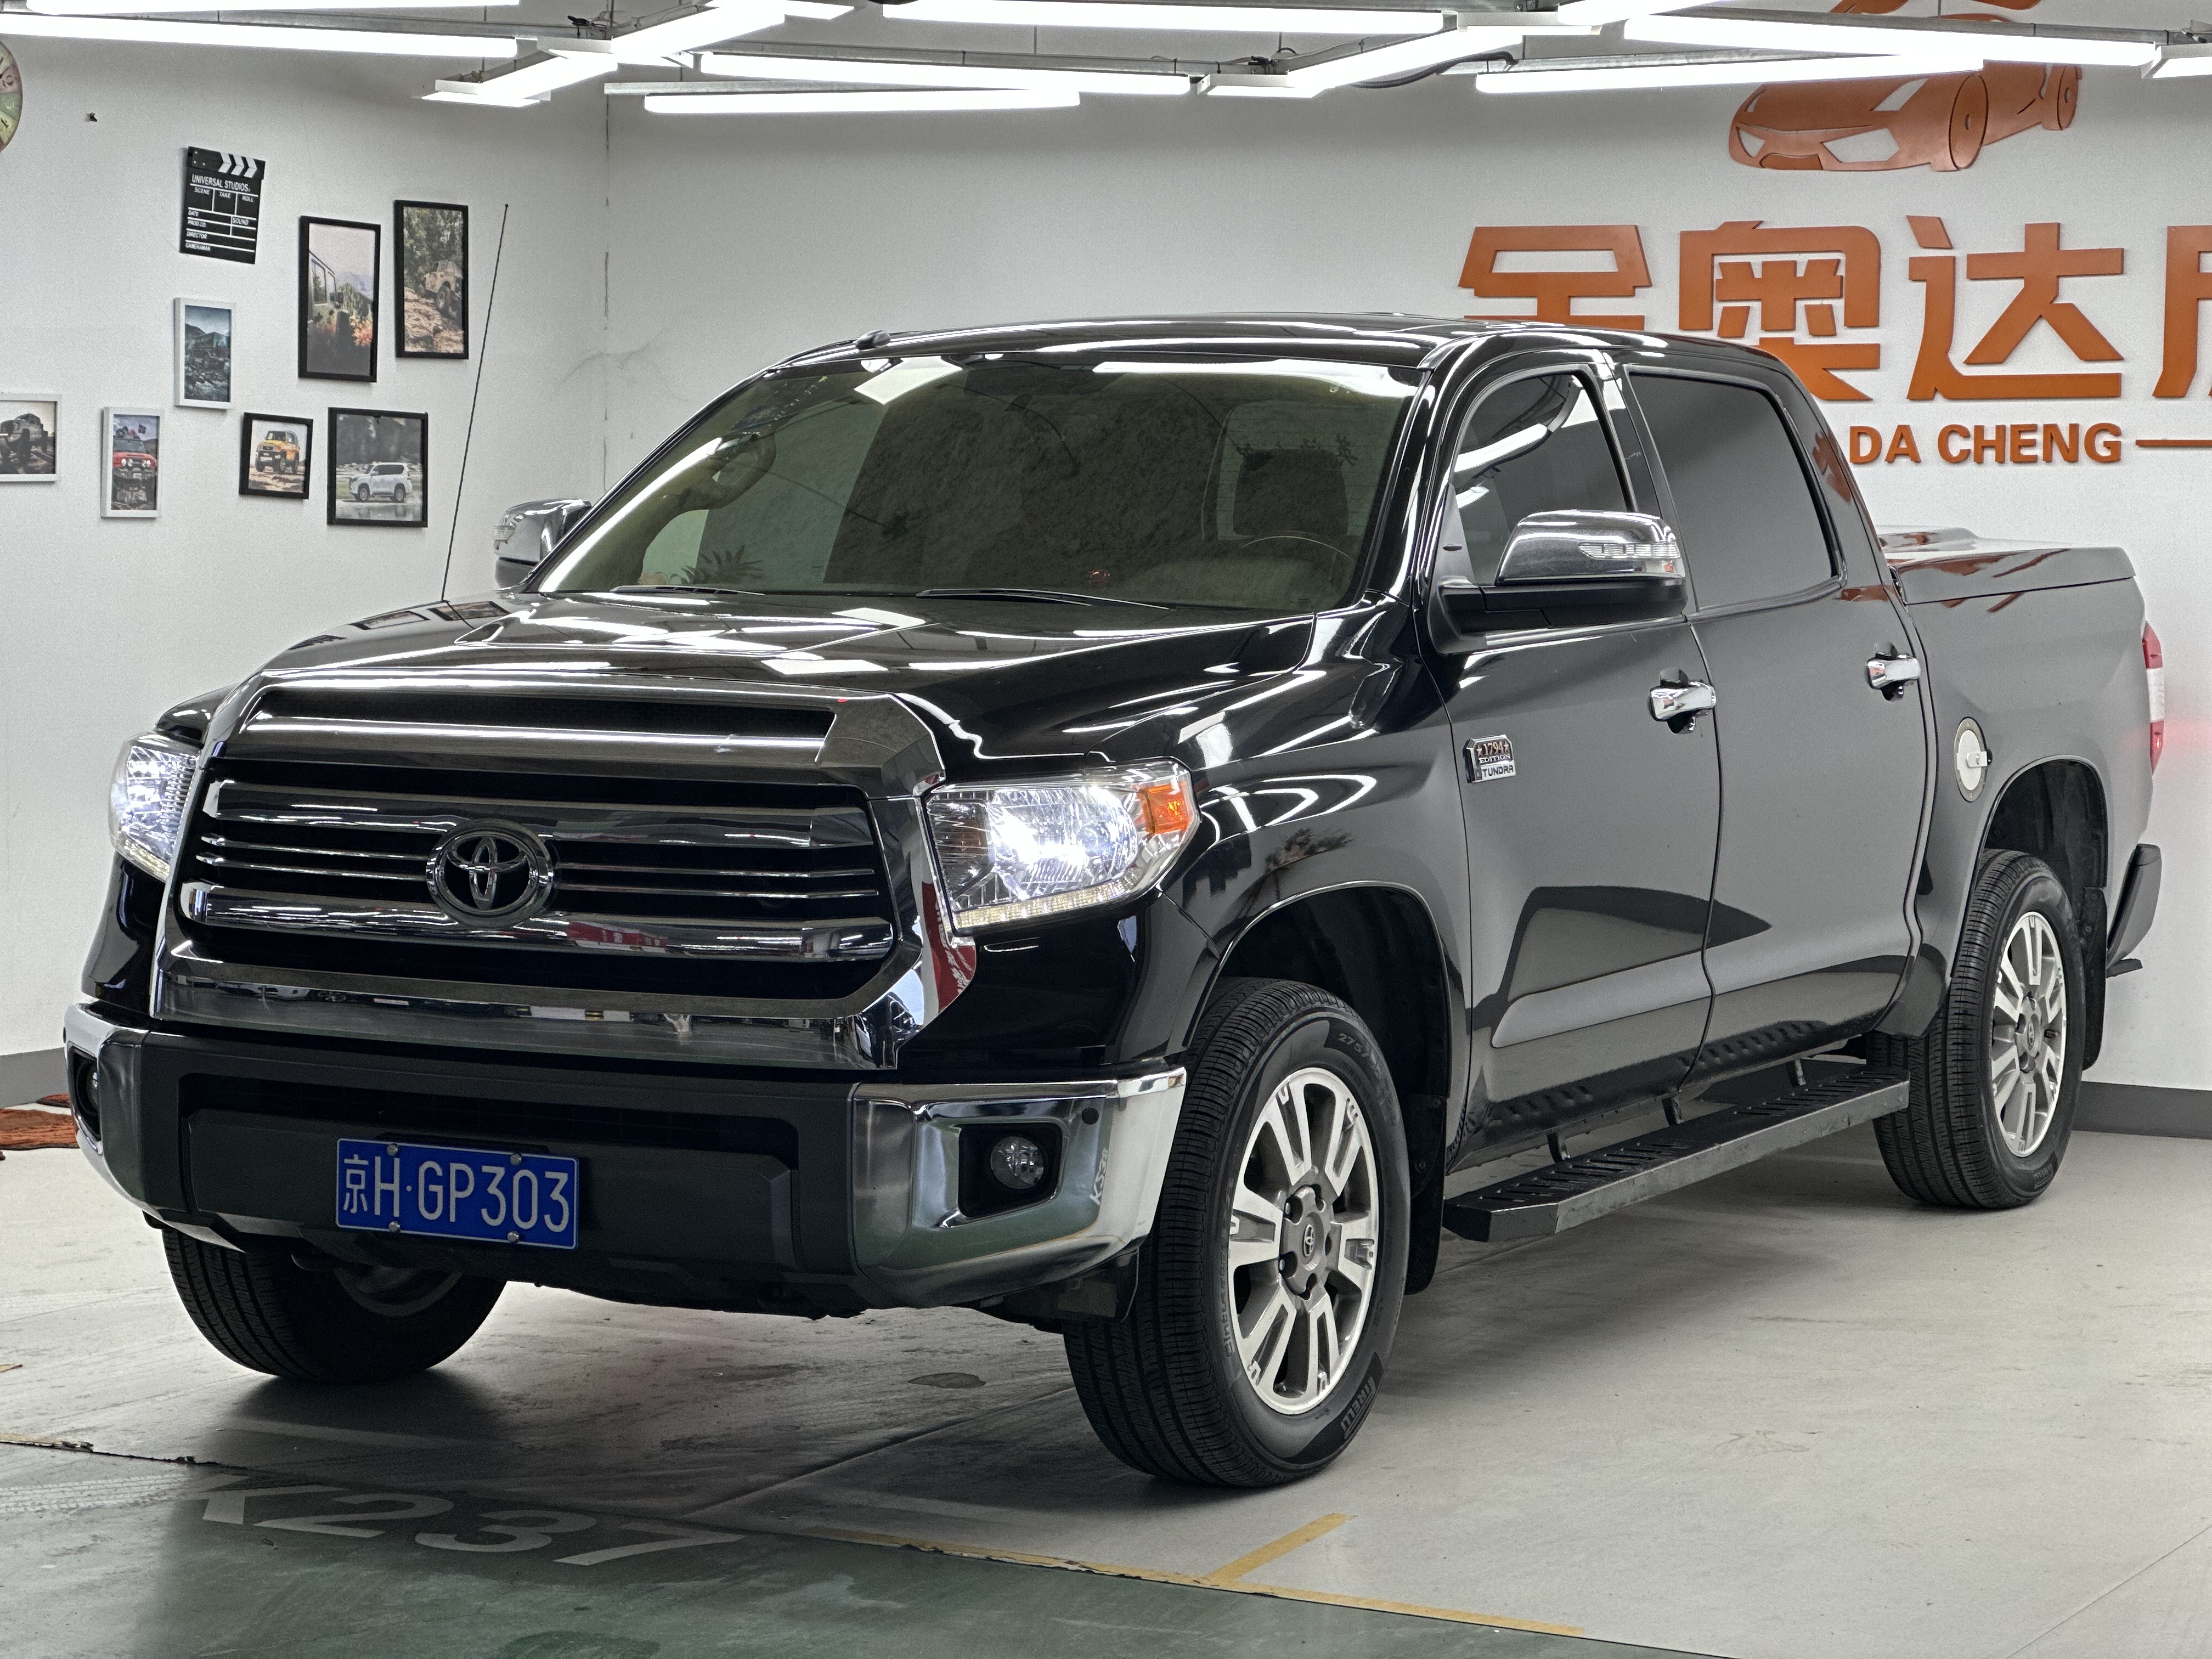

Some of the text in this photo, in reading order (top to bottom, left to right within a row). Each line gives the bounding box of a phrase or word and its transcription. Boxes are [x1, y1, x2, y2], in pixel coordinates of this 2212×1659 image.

[192, 174, 249, 191] UNIVERSAL STUDIOS
[232, 217, 249, 225] SOUND
[186, 231, 207, 240] DIRECTOR
[185, 242, 211, 251] CAMERAMAN
[1849, 422, 2123, 464] DA CHENG
[1483, 741, 1503, 755] 1794
[1479, 754, 1510, 764] EDITION
[1482, 765, 1514, 777] TUNDRA
[1340, 1375, 1377, 1440] PIRELLI
